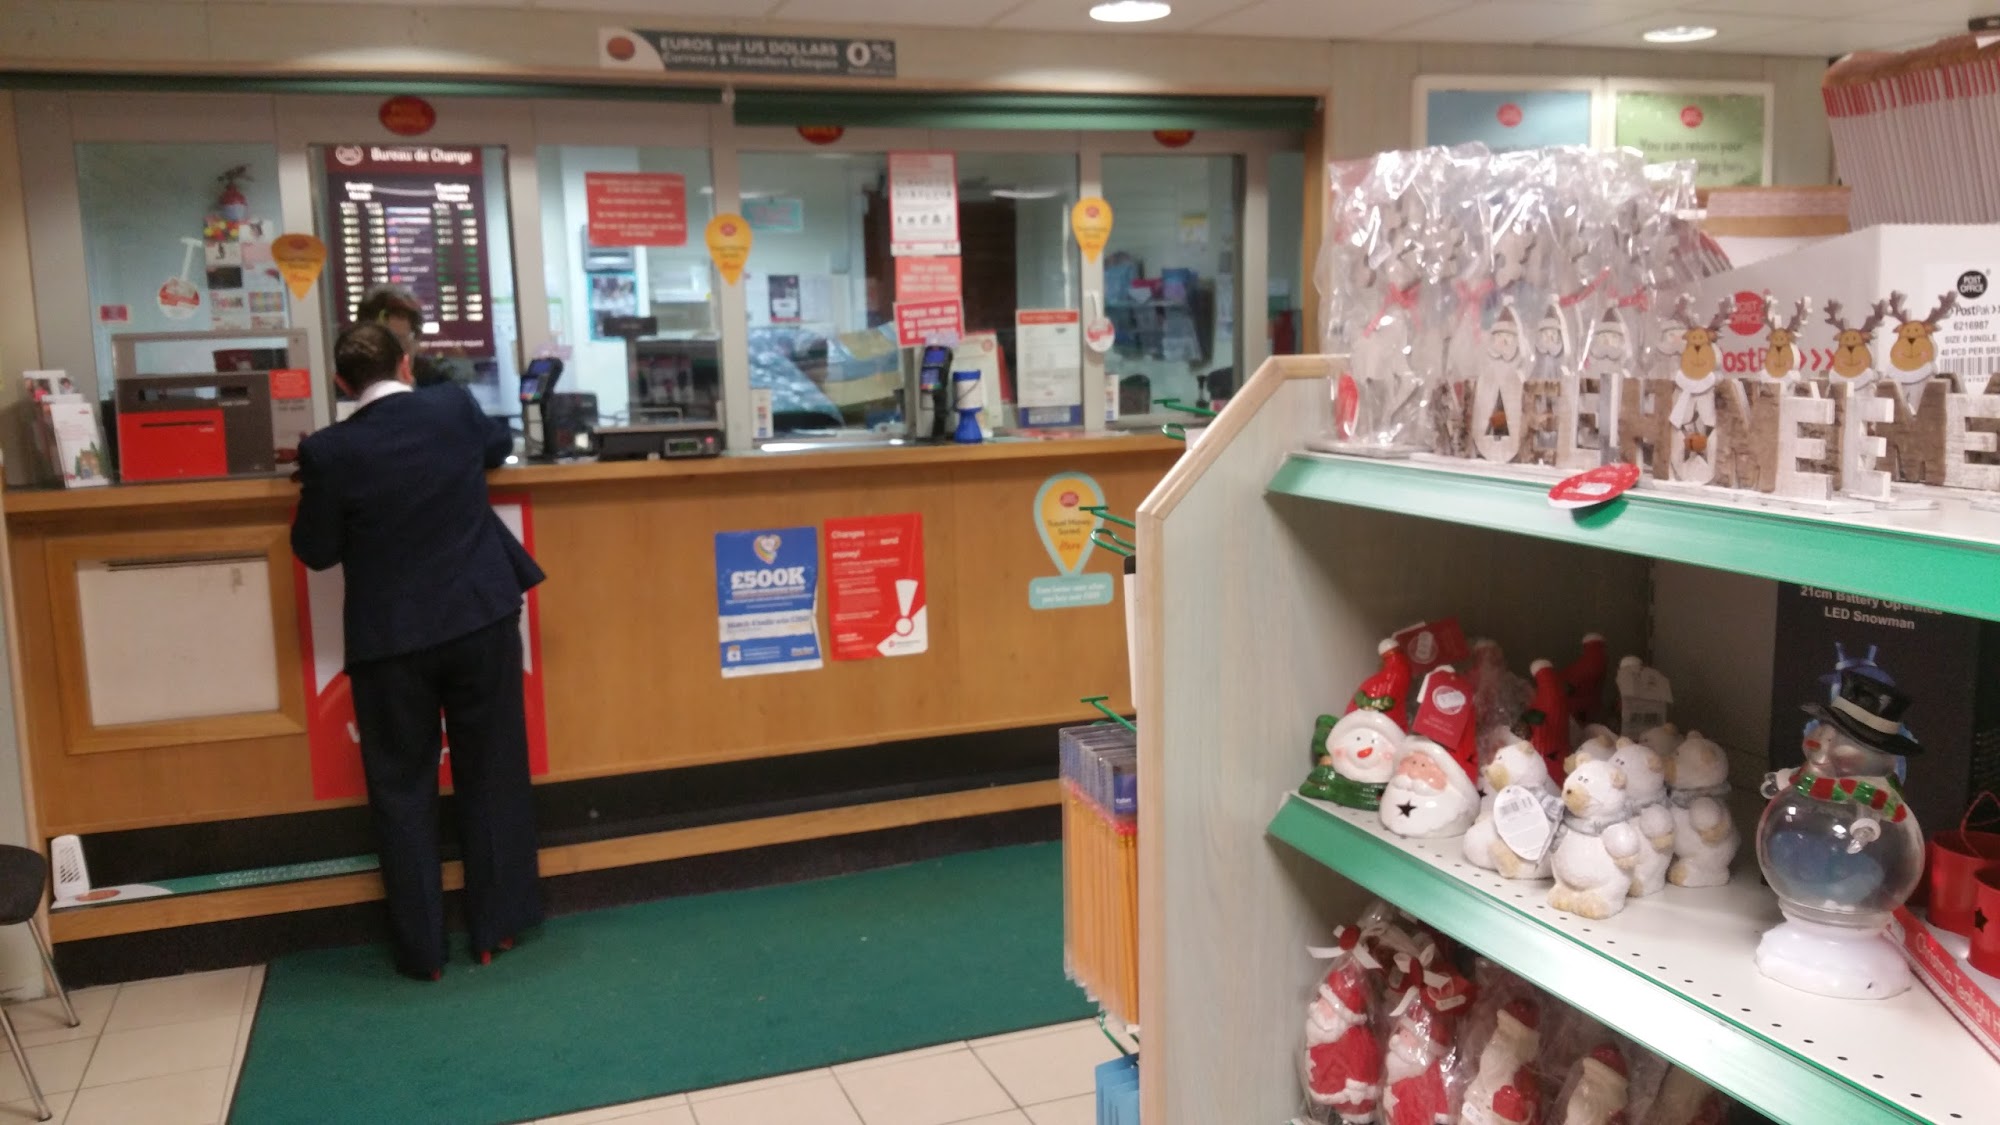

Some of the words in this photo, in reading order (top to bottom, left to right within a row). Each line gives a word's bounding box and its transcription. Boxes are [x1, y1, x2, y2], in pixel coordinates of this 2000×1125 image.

[660, 37, 713, 51] EUROS
[717, 41, 741, 52] and
[744, 40, 765, 54] US
[769, 41, 838, 57] DOLLARS
[1640, 138, 1660, 152] You
[1663, 142, 1682, 152] can
[1686, 141, 1717, 152] return
[1720, 142, 1744, 155] your
[371, 146, 412, 162] Bureau
[414, 148, 429, 162] de
[431, 148, 472, 166] Change
[1964, 276, 1982, 285] POST
[1960, 284, 1984, 293] OFFICE
[1945, 336, 1961, 344] SIZE
[1970, 334, 1997, 343] SINGLE
[1951, 348, 1967, 356] PCS
[1968, 347, 1984, 355] PER
[832, 529, 865, 540] Changes
[880, 536, 899, 546] send
[731, 566, 806, 590] £500K
[1801, 586, 1832, 600] 21cm
[1836, 591, 1880, 609] Battery
[1824, 606, 1850, 620] LED
[1853, 610, 1915, 630] Snowman
